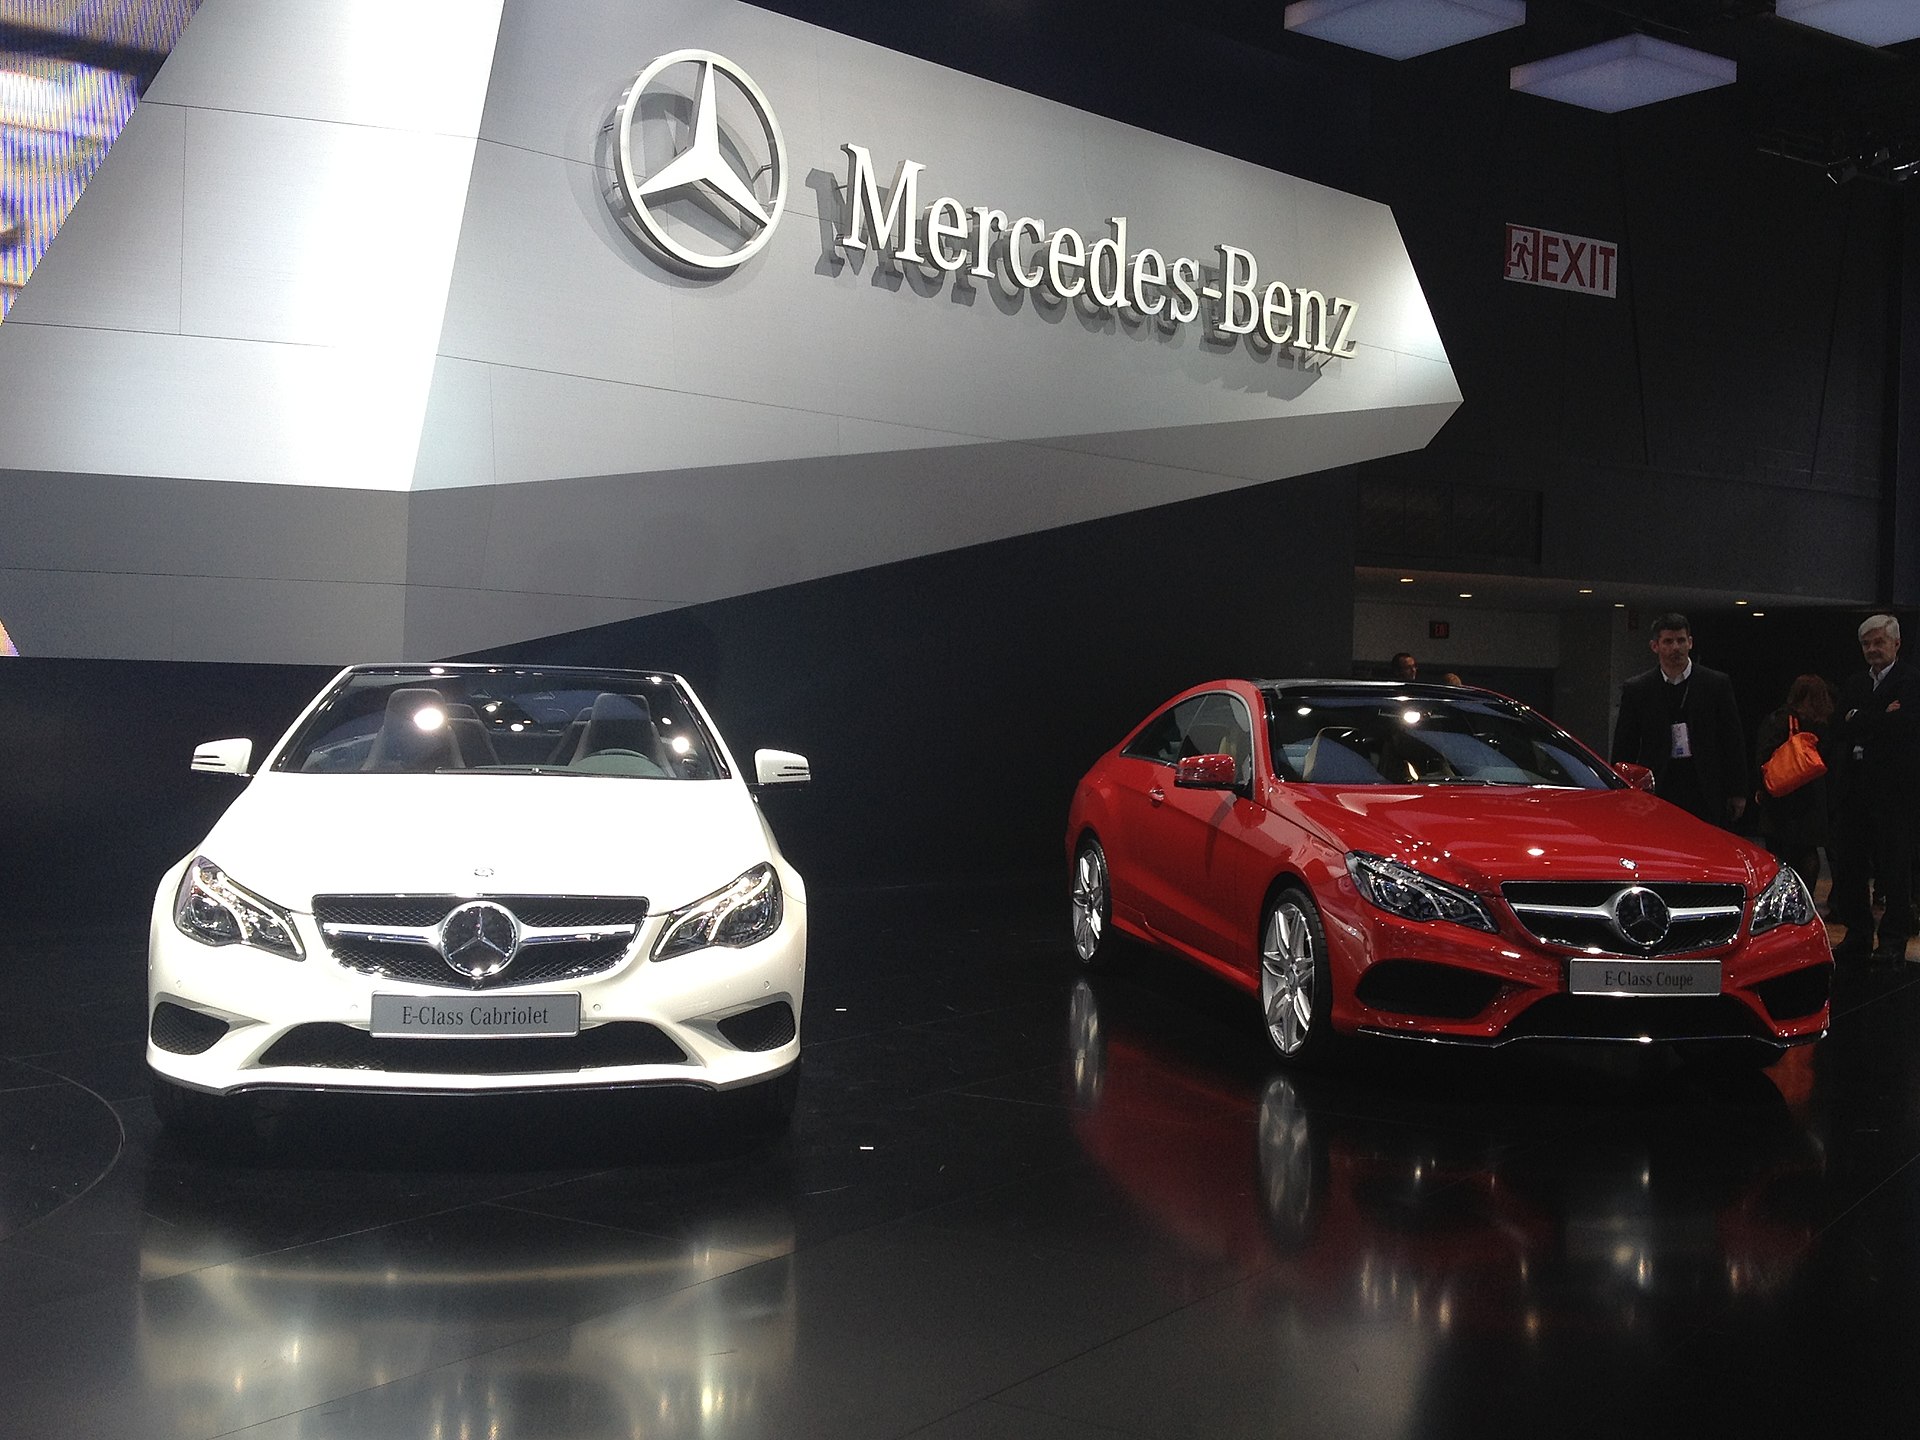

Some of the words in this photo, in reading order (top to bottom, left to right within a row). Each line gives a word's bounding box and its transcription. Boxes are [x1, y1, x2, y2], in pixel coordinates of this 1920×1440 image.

[839, 142, 1359, 360] Mercedes-Benz
[1541, 235, 1616, 291] EXIT
[1604, 970, 1652, 987] E-Class
[1656, 971, 1694, 990] Coupe
[402, 1006, 464, 1026] E-Class
[470, 1006, 549, 1026] Cabriolet
